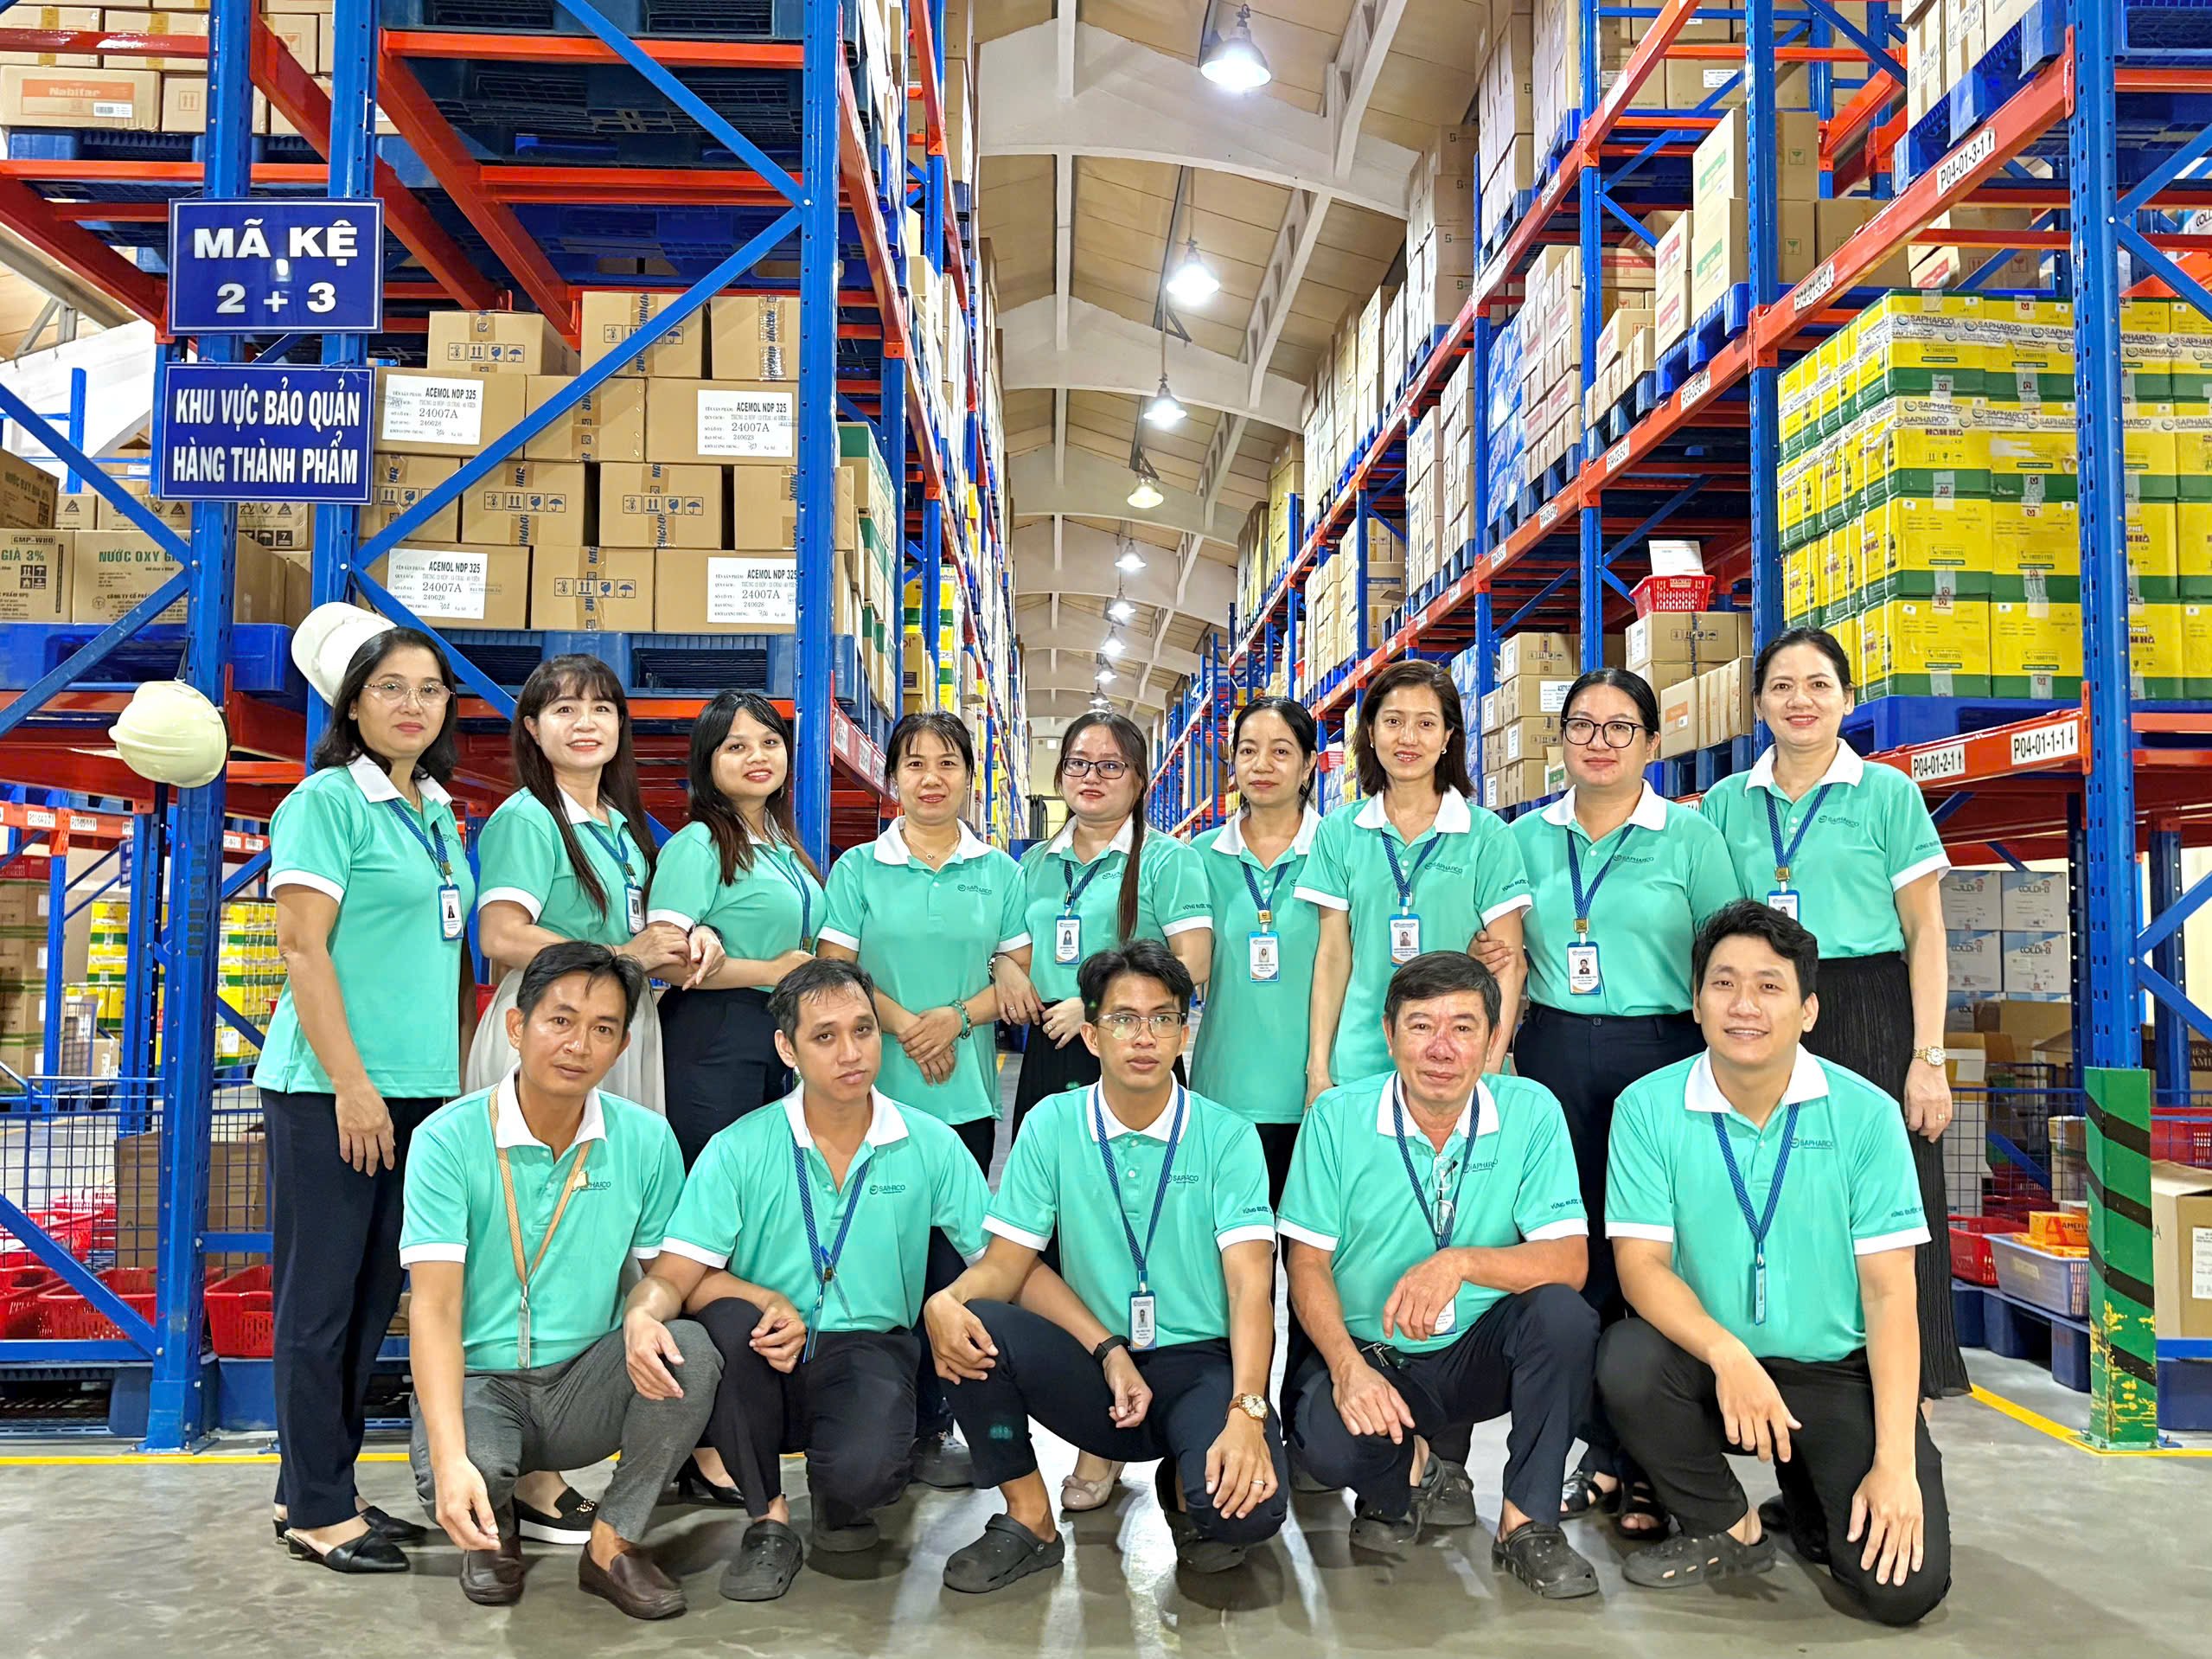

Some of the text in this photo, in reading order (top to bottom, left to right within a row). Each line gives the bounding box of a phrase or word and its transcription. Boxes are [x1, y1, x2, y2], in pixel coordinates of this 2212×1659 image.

[194, 218, 358, 267] MÃ KỆ
[215, 281, 336, 314] 2 + 3
[425, 387, 451, 399] ACEMOL
[451, 388, 464, 400] NDP
[465, 389, 476, 400] 325
[176, 388, 215, 425] KHU
[221, 382, 259, 432] VỰC
[264, 376, 304, 426] BẢO
[308, 378, 361, 432] QUẢN
[736, 401, 787, 413] ACEMOL NDP 325
[419, 408, 458, 420] 24007A
[731, 422, 770, 432] 24007A
[173, 430, 359, 484] HÀNG THÀNH PHẨM
[1, 547, 45, 561] GIÀ 3%
[99, 548, 131, 562] NƯỚC
[136, 551, 160, 562] OXY
[428, 560, 454, 573] ACEMOL
[455, 562, 468, 573] NDP
[469, 562, 481, 573] 325
[747, 568, 797, 580] ACEMOL NDP 325
[422, 582, 463, 593] 24007A
[741, 589, 780, 599] 24007A
[2013, 727, 2065, 759] P04-01-1-1
[1913, 752, 1956, 778] P04-01-2-1
